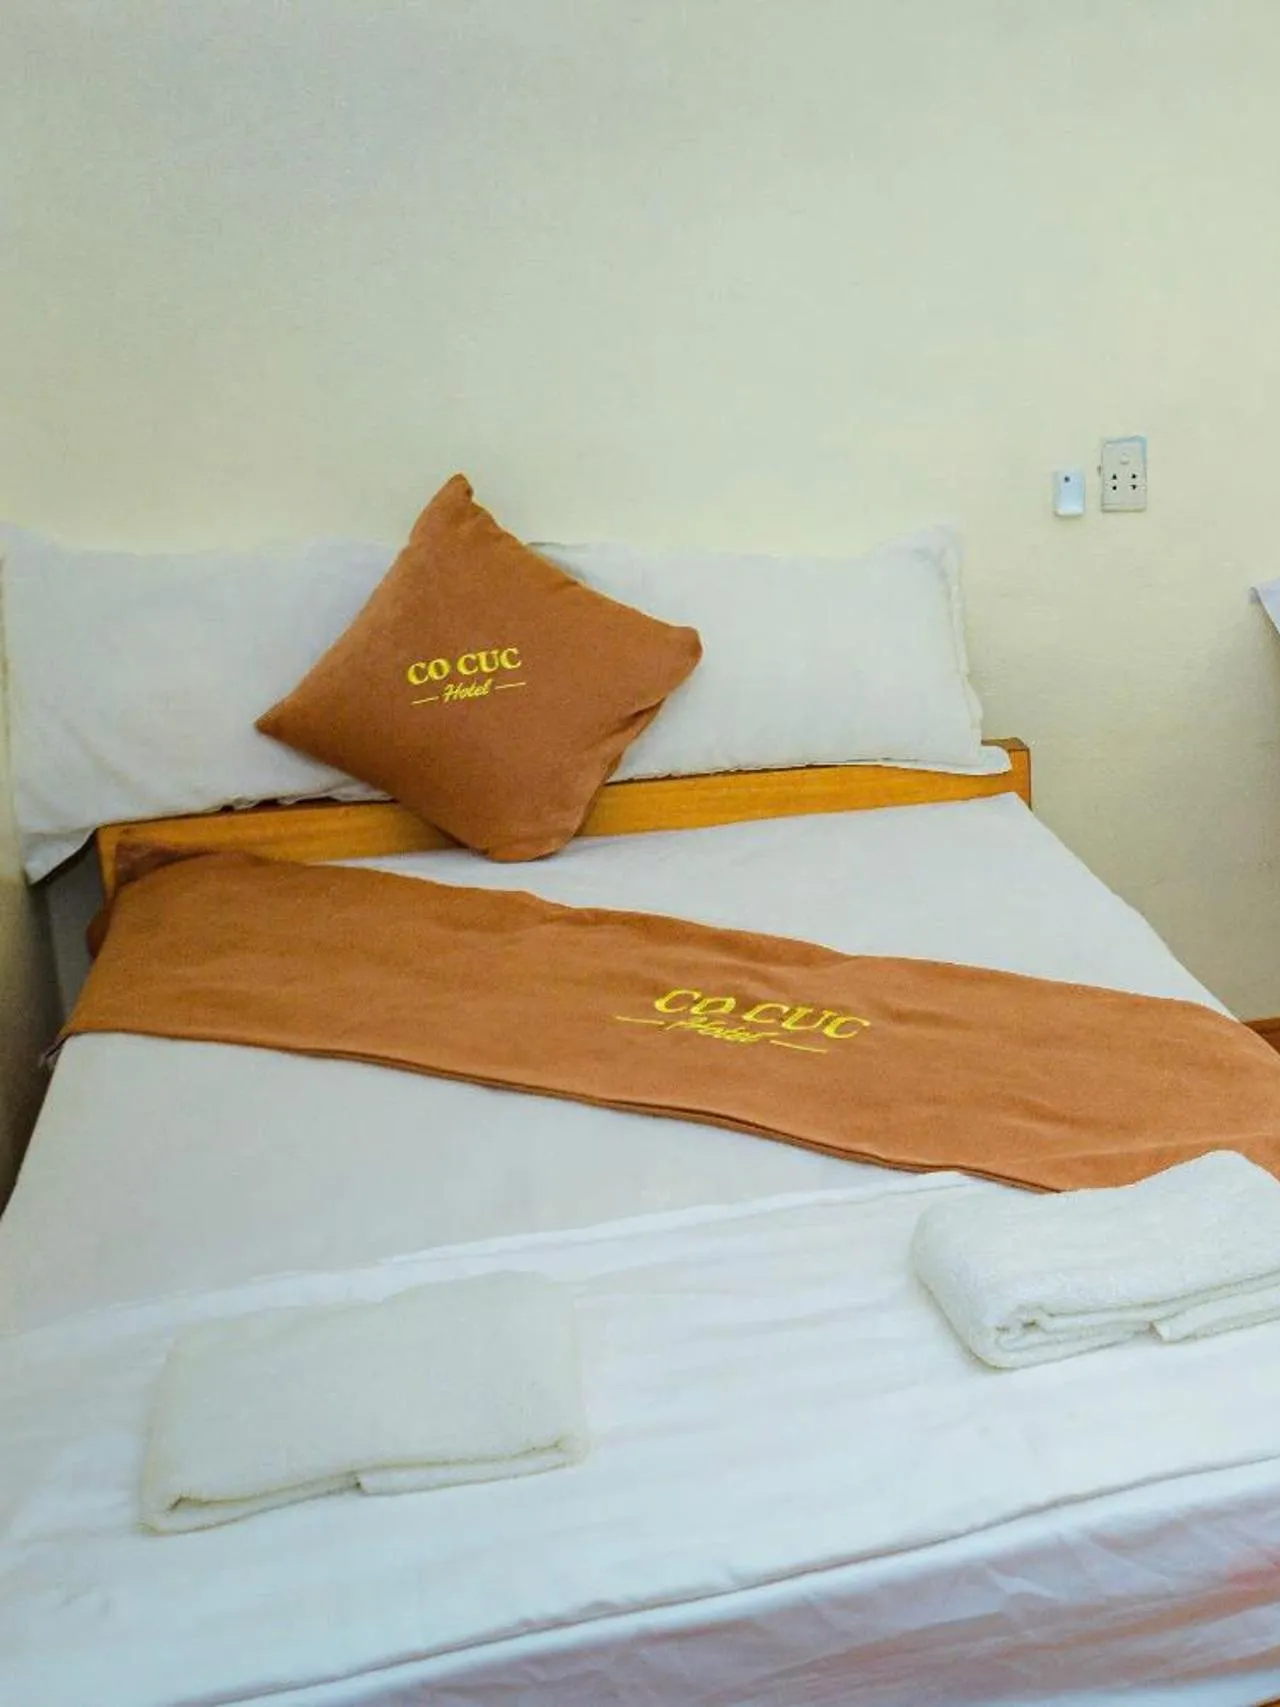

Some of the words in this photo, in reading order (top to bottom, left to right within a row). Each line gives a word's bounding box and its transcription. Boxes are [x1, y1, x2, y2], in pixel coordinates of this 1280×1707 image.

[407, 658, 450, 685] CO
[457, 647, 522, 676] CUC
[443, 678, 493, 703] Hotel
[654, 990, 736, 1015] CO
[742, 1003, 871, 1039] CUC
